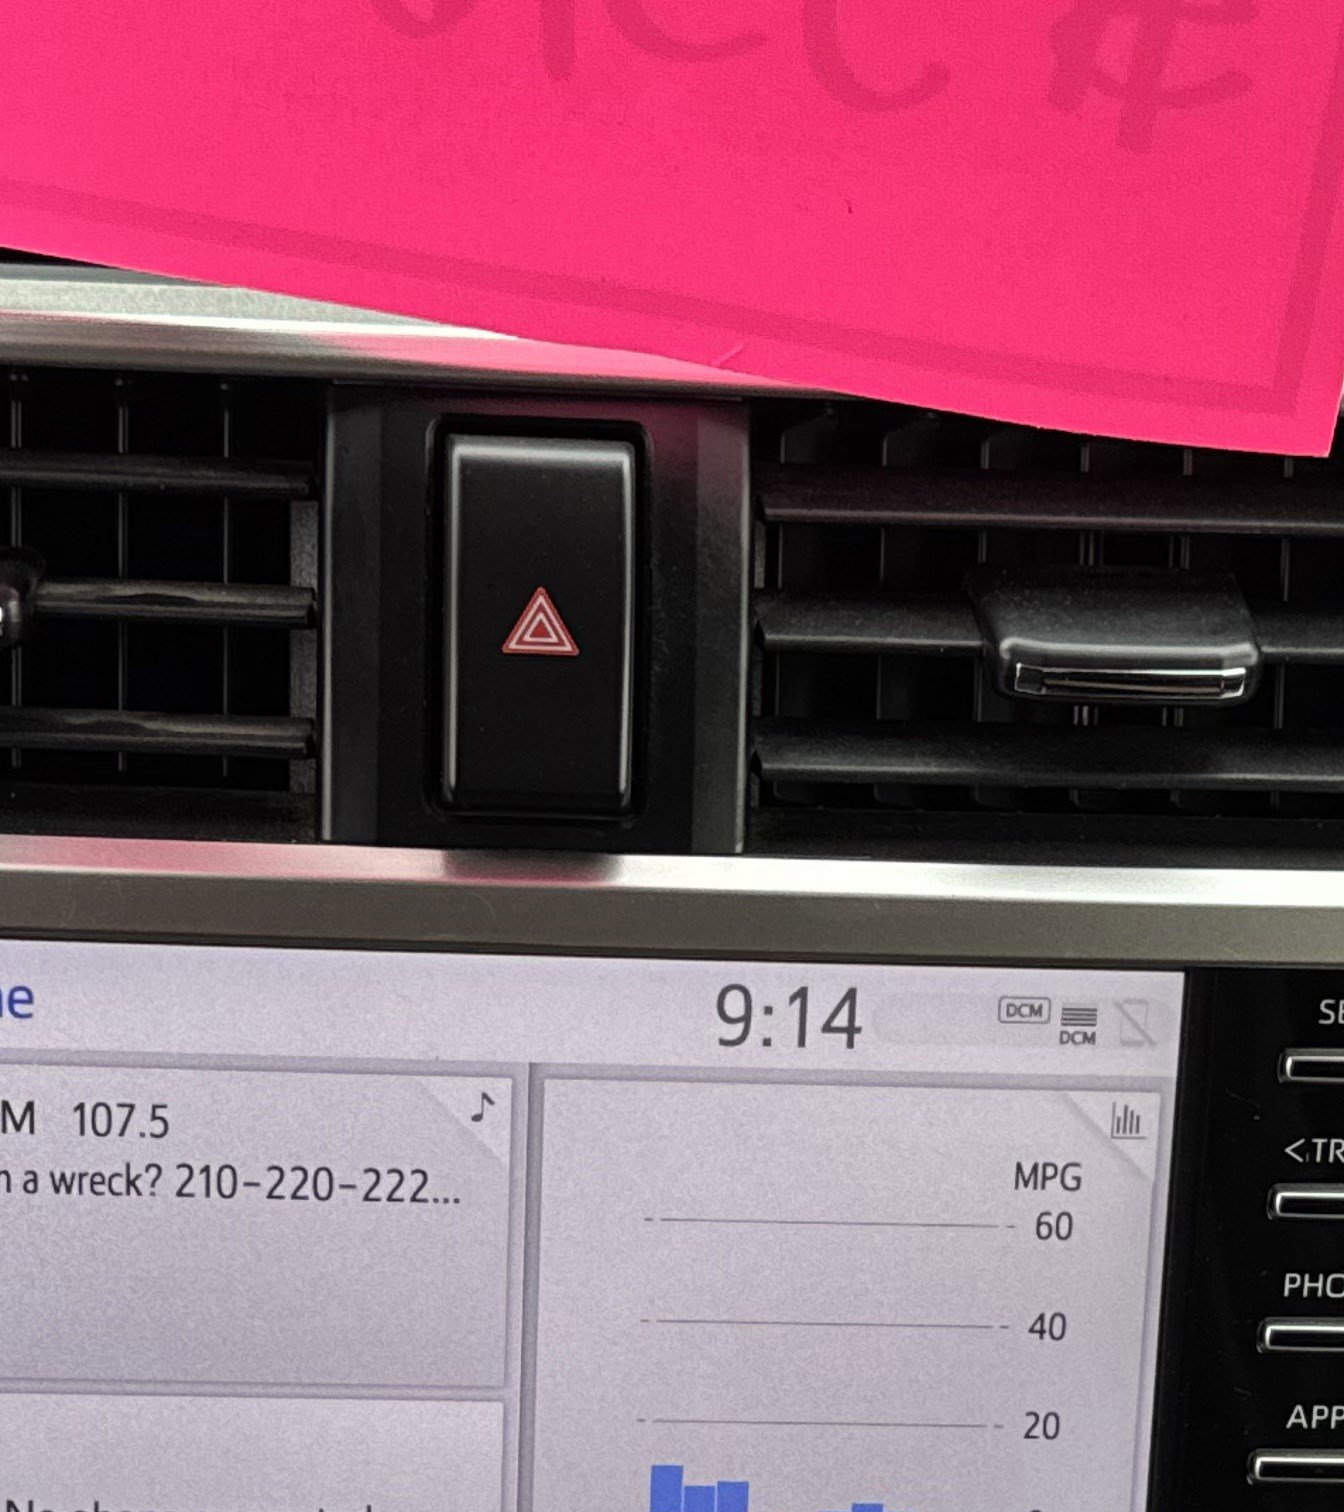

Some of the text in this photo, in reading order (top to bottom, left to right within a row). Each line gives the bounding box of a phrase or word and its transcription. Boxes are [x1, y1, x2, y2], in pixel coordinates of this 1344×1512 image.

[716, 982, 863, 1050] 9:14
[1005, 1001, 1043, 1020] DCM
[1059, 1029, 1097, 1046] DCM
[72, 1101, 170, 1139] 107.5
[22, 1168, 38, 1195] a
[49, 1161, 163, 1198] wreck?
[1013, 1160, 1082, 1192] MPG
[1034, 1210, 1074, 1241] 60
[1027, 1311, 1067, 1342] 40
[1022, 1411, 1061, 1440] 20
